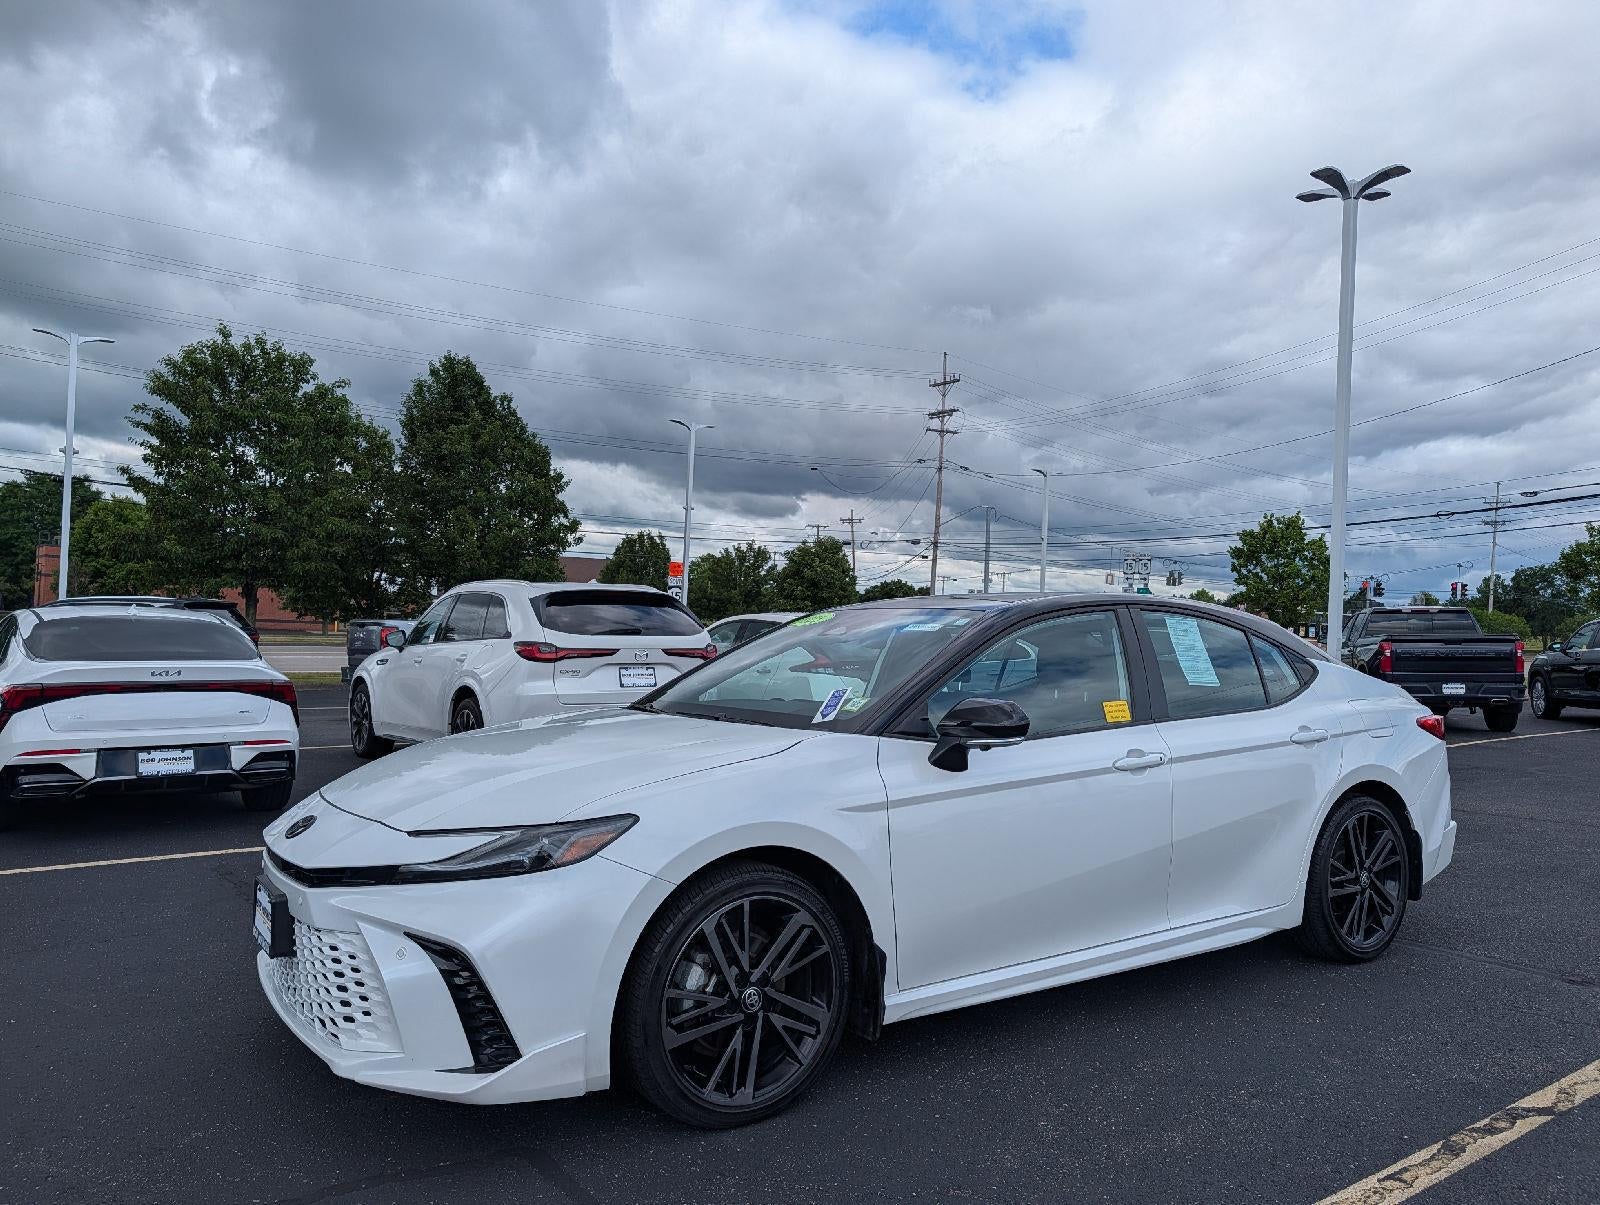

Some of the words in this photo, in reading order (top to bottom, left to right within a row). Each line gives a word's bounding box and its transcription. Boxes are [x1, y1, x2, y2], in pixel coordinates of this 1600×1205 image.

[1125, 562, 1134, 571] 15
[1140, 562, 1149, 571] 15
[671, 591, 681, 600] 15
[1400, 648, 1505, 657] CHEVROLET
[150, 669, 182, 677] KIA
[157, 755, 193, 763] JOHNSON
[158, 768, 192, 777] JOHNSON
